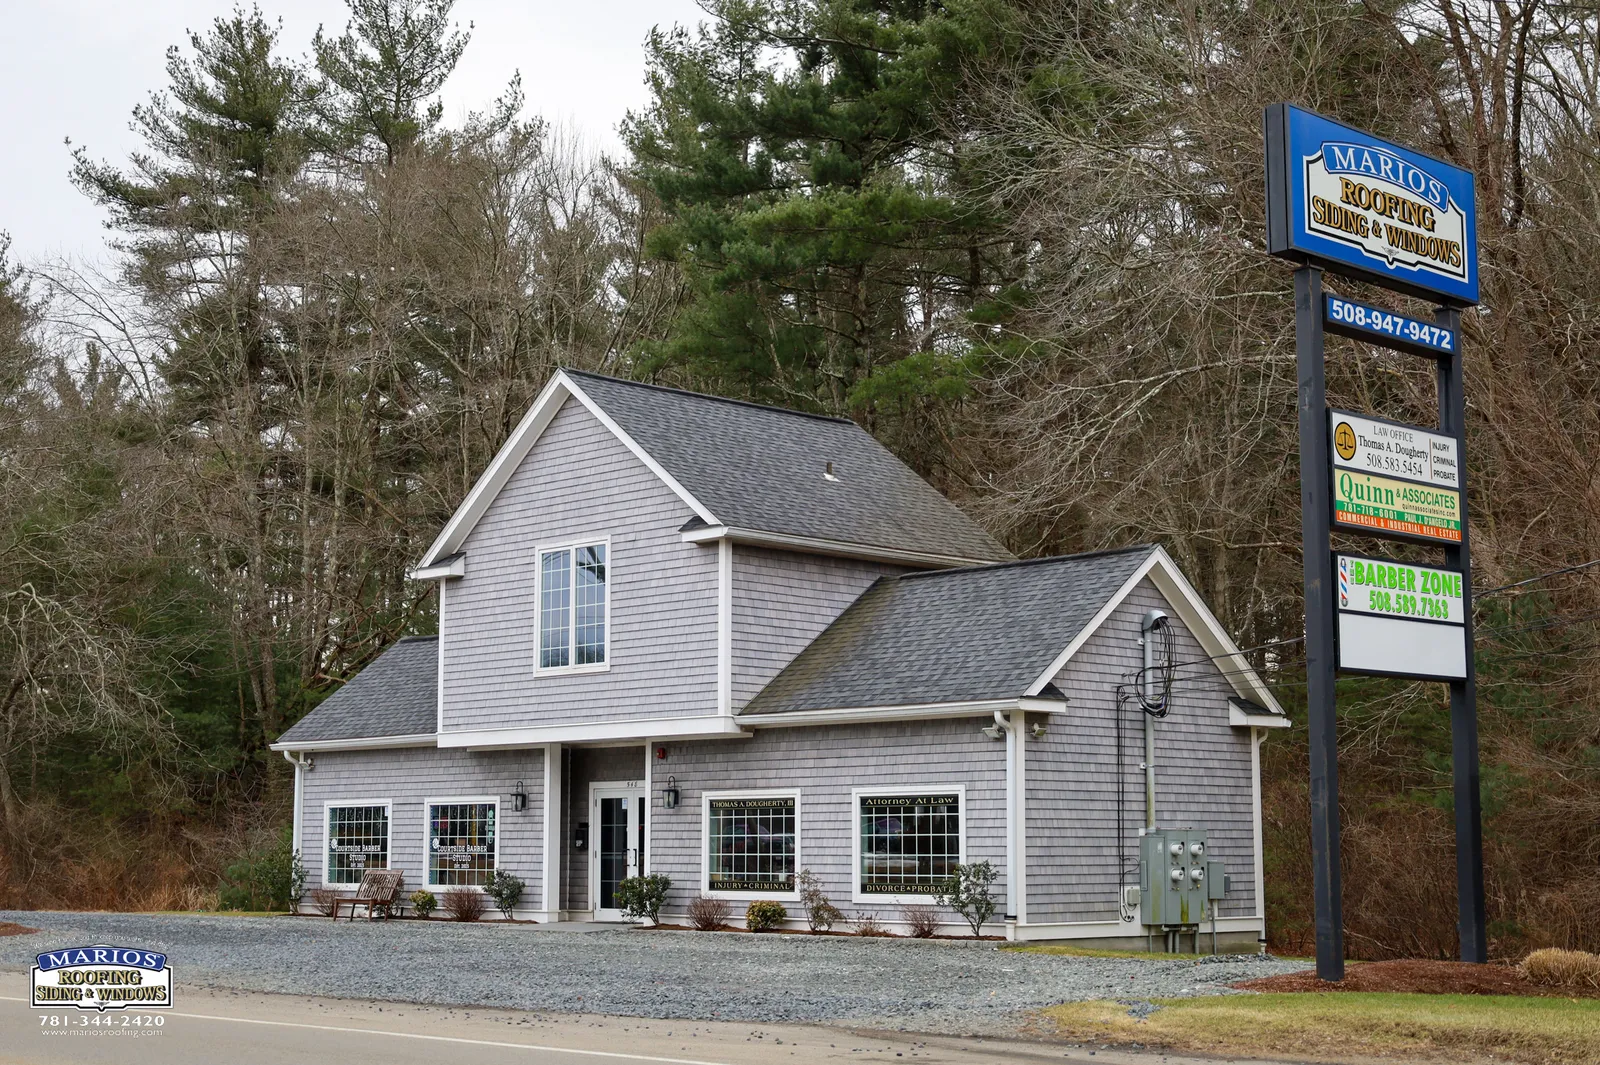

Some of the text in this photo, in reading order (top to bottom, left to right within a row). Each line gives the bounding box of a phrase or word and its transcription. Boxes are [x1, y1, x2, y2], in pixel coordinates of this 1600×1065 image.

[1332, 146, 1441, 204] MARIOS
[1339, 177, 1435, 232] ROOFING
[1312, 195, 1461, 267] SIDING & WINDOWS
[1332, 299, 1451, 349] 508-947-9472
[1373, 425, 1413, 443] LAW OFFICE
[1432, 441, 1450, 452] INJURY
[1358, 435, 1429, 462] Thomas A. Dougherty
[1432, 456, 1456, 468] CRIMINAL
[1366, 453, 1423, 476] 508.583.5454
[1433, 469, 1456, 481] PROBATE
[1340, 472, 1456, 509] Quinn & ASSOCIATES
[1343, 502, 1398, 520] 781-718-6001
[1339, 511, 1378, 526] COMMERCIAL
[1387, 520, 1421, 533] INDUSTRIAL
[1423, 526, 1437, 536] REAL
[1439, 528, 1459, 539] ESTATE
[1354, 561, 1462, 598] BARBER ZONE
[1369, 590, 1449, 620] 508.589.7363
[866, 798, 912, 806] Attorney
